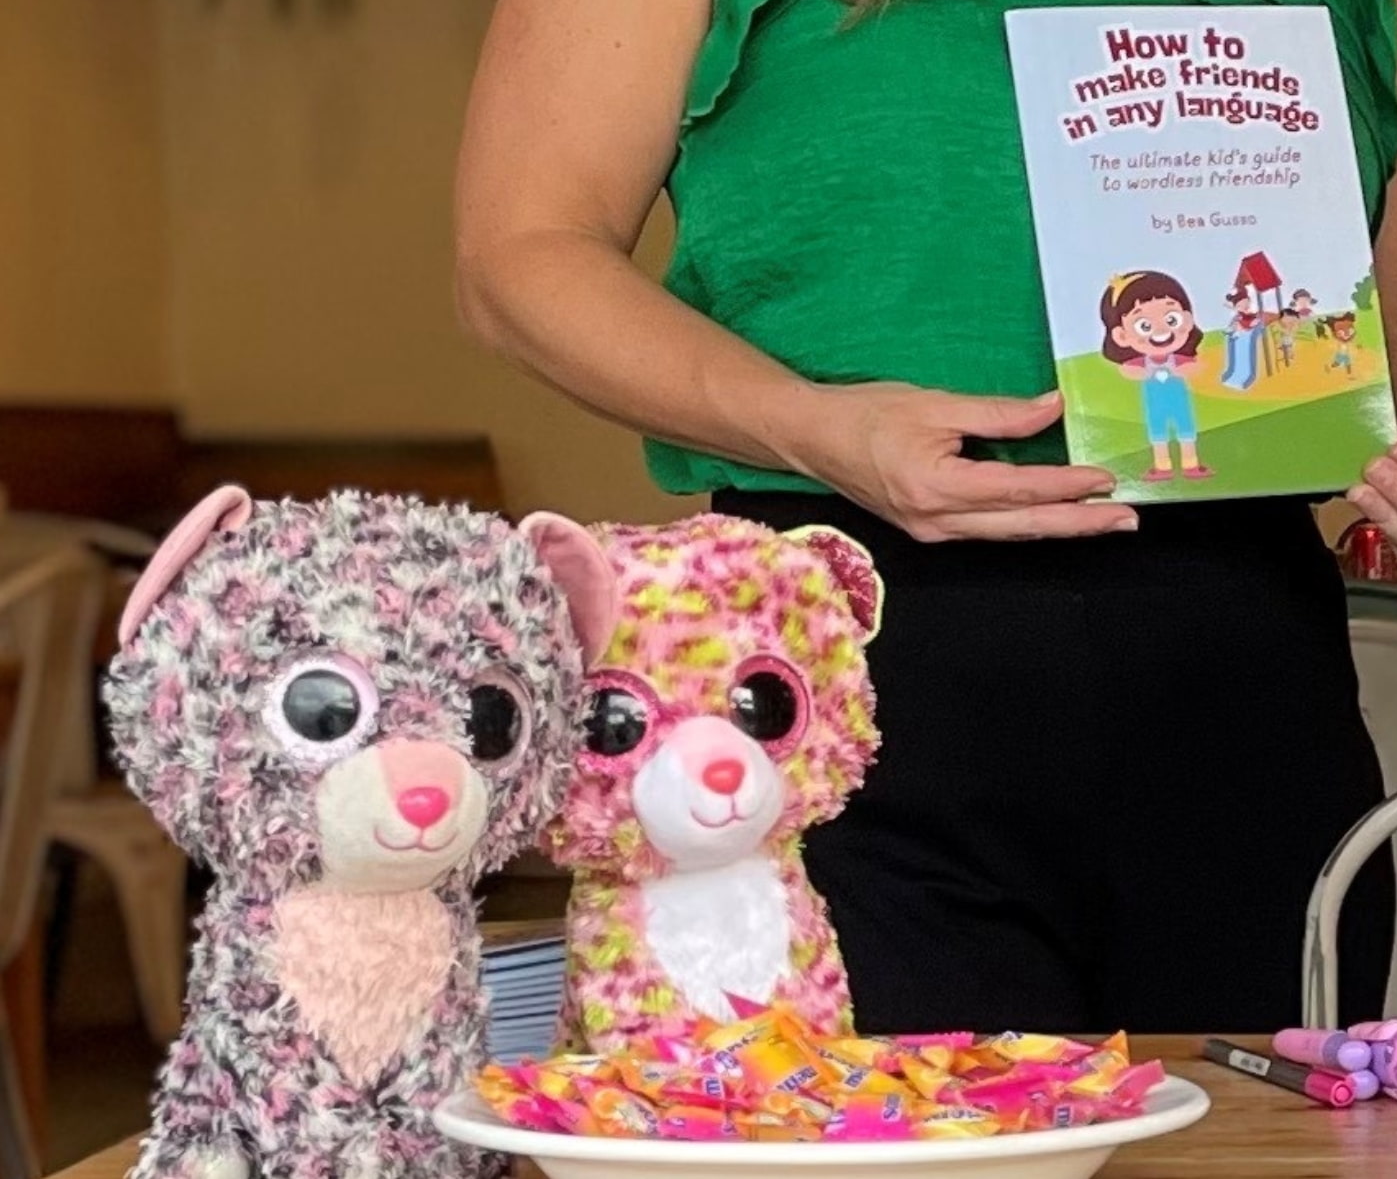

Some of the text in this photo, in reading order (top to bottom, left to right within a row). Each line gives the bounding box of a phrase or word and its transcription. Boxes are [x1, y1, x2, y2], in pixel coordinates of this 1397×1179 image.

[1106, 27, 1245, 62] How to
[1075, 60, 1300, 102] make friends
[1063, 91, 1320, 141] in any language
[1089, 146, 1302, 171] The ultimate kid's guide
[1103, 168, 1301, 191] to wordless friendship
[1151, 214, 1173, 233] by
